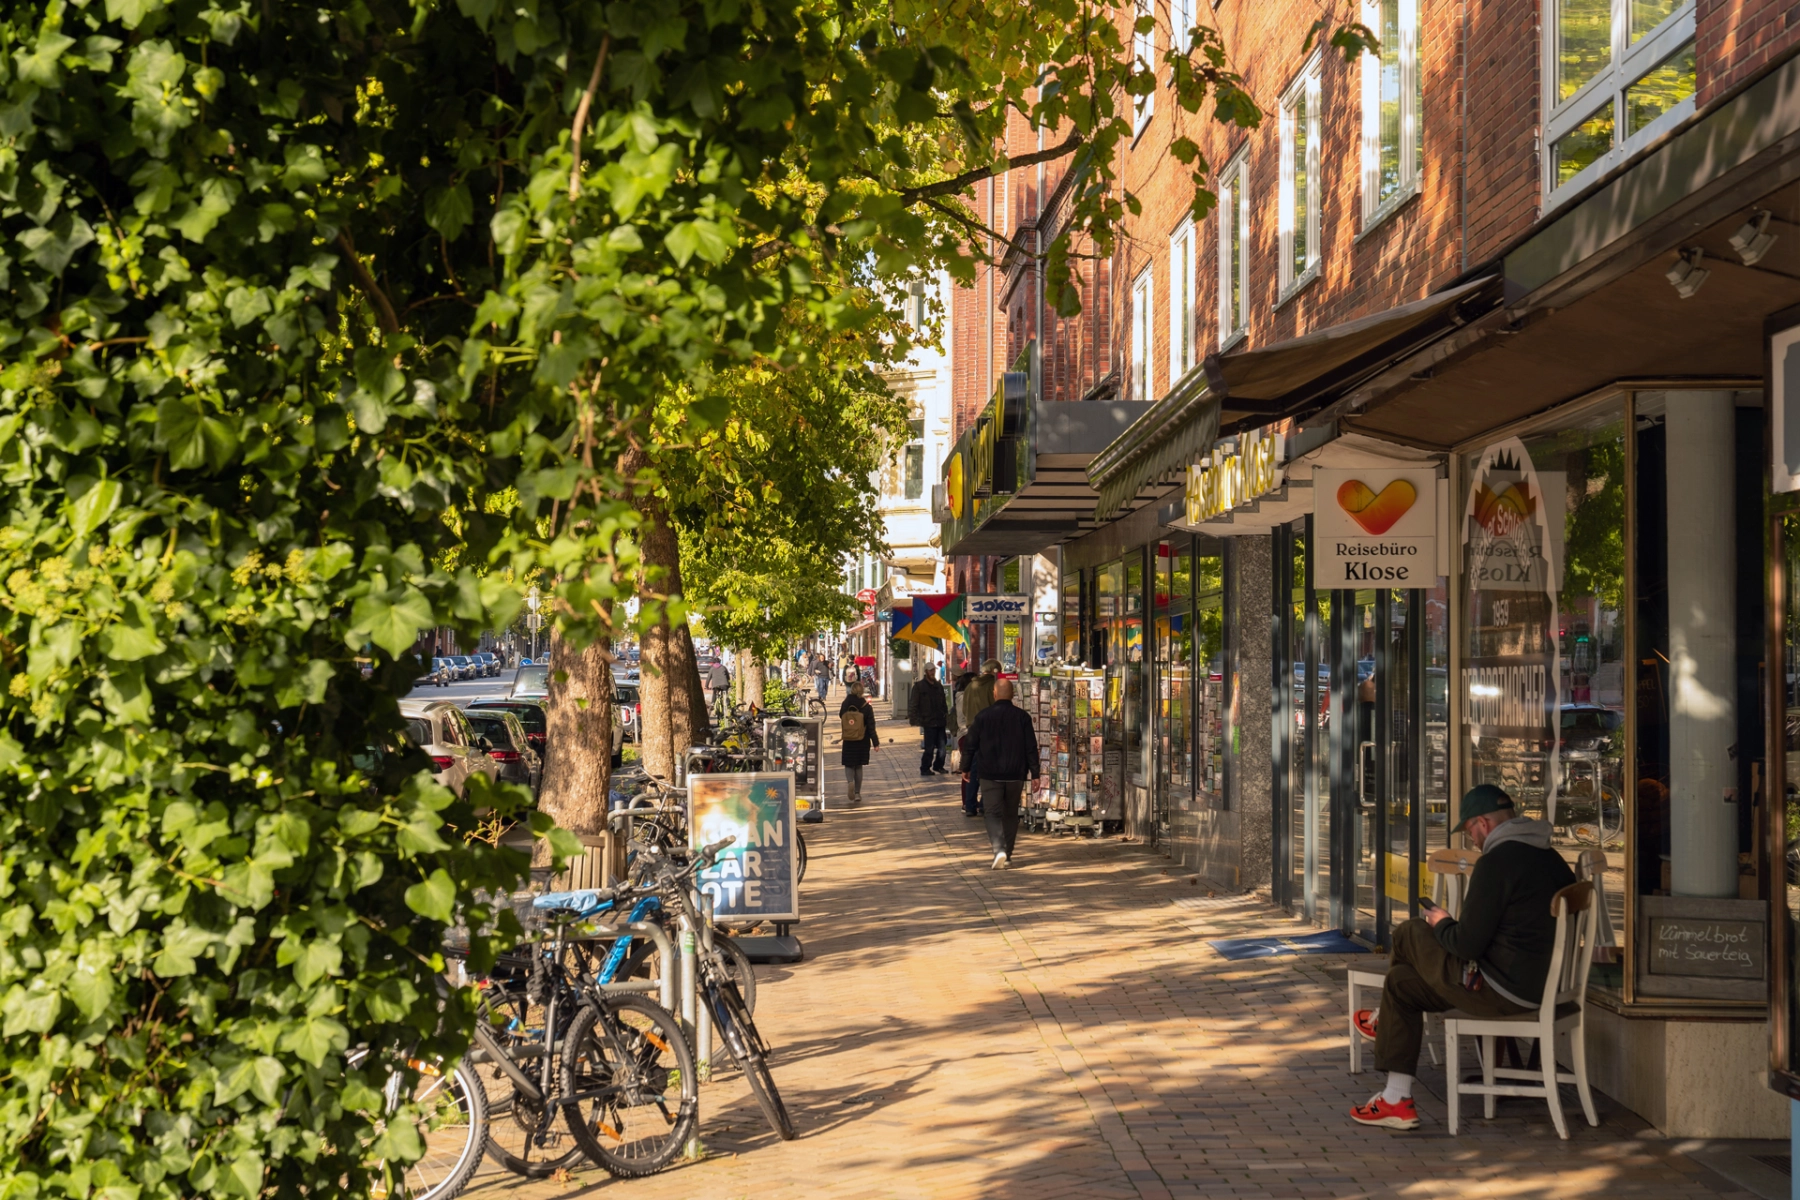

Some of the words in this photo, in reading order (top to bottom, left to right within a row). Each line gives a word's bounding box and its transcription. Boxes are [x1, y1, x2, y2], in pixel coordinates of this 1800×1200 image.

[1336, 542, 1418, 556] Reisebüro
[1344, 561, 1410, 581] Klose
[1480, 664, 1546, 728] BROTMACHER
[1658, 944, 1680, 959] mit
[1685, 944, 1754, 967] Sauerteig
